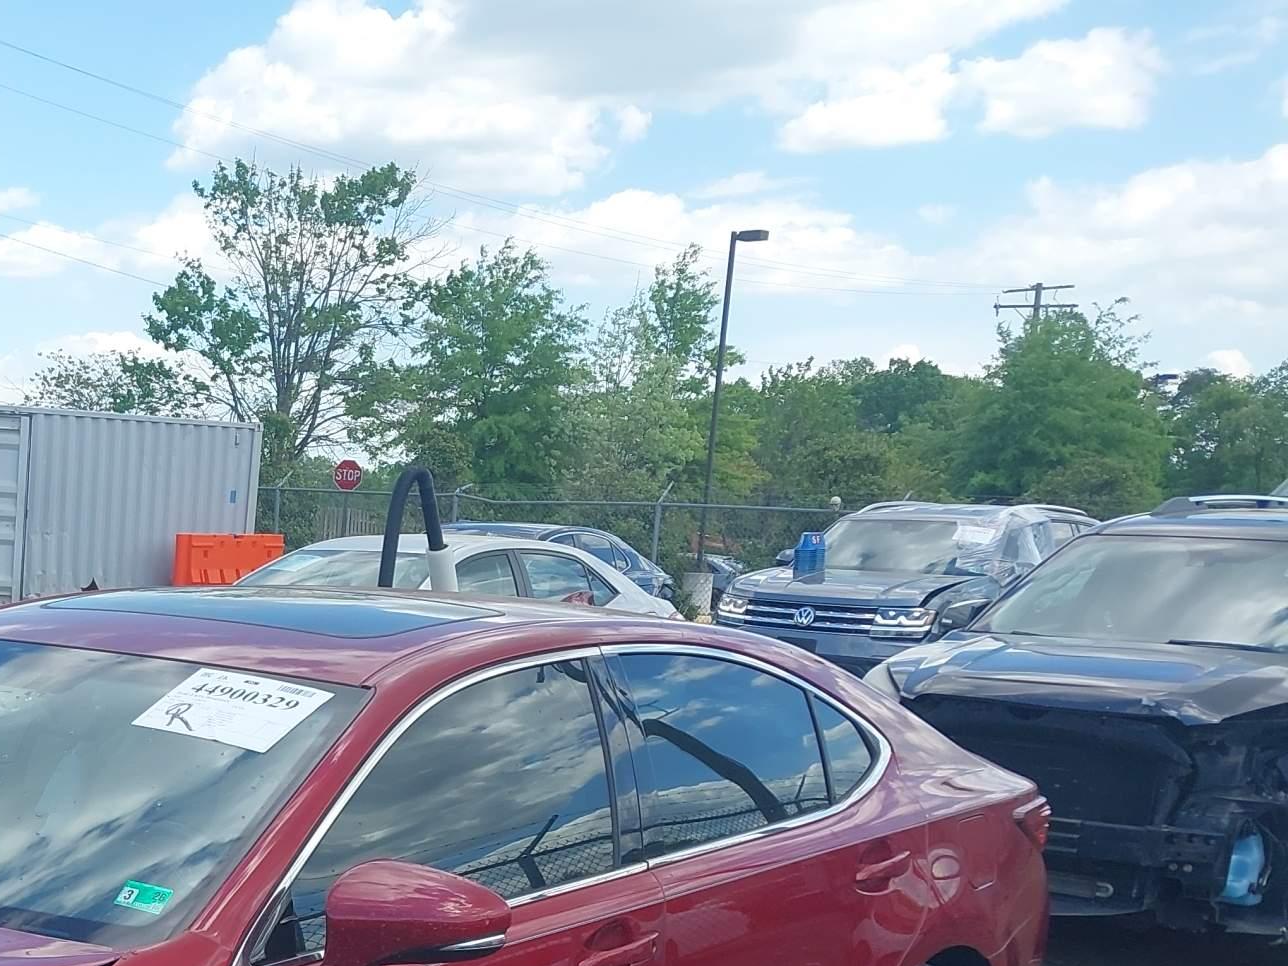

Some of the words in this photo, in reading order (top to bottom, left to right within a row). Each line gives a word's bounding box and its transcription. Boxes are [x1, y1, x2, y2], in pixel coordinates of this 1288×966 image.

[335, 469, 361, 481] STOP
[191, 682, 300, 711] 44900329
[123, 889, 135, 901] 3
